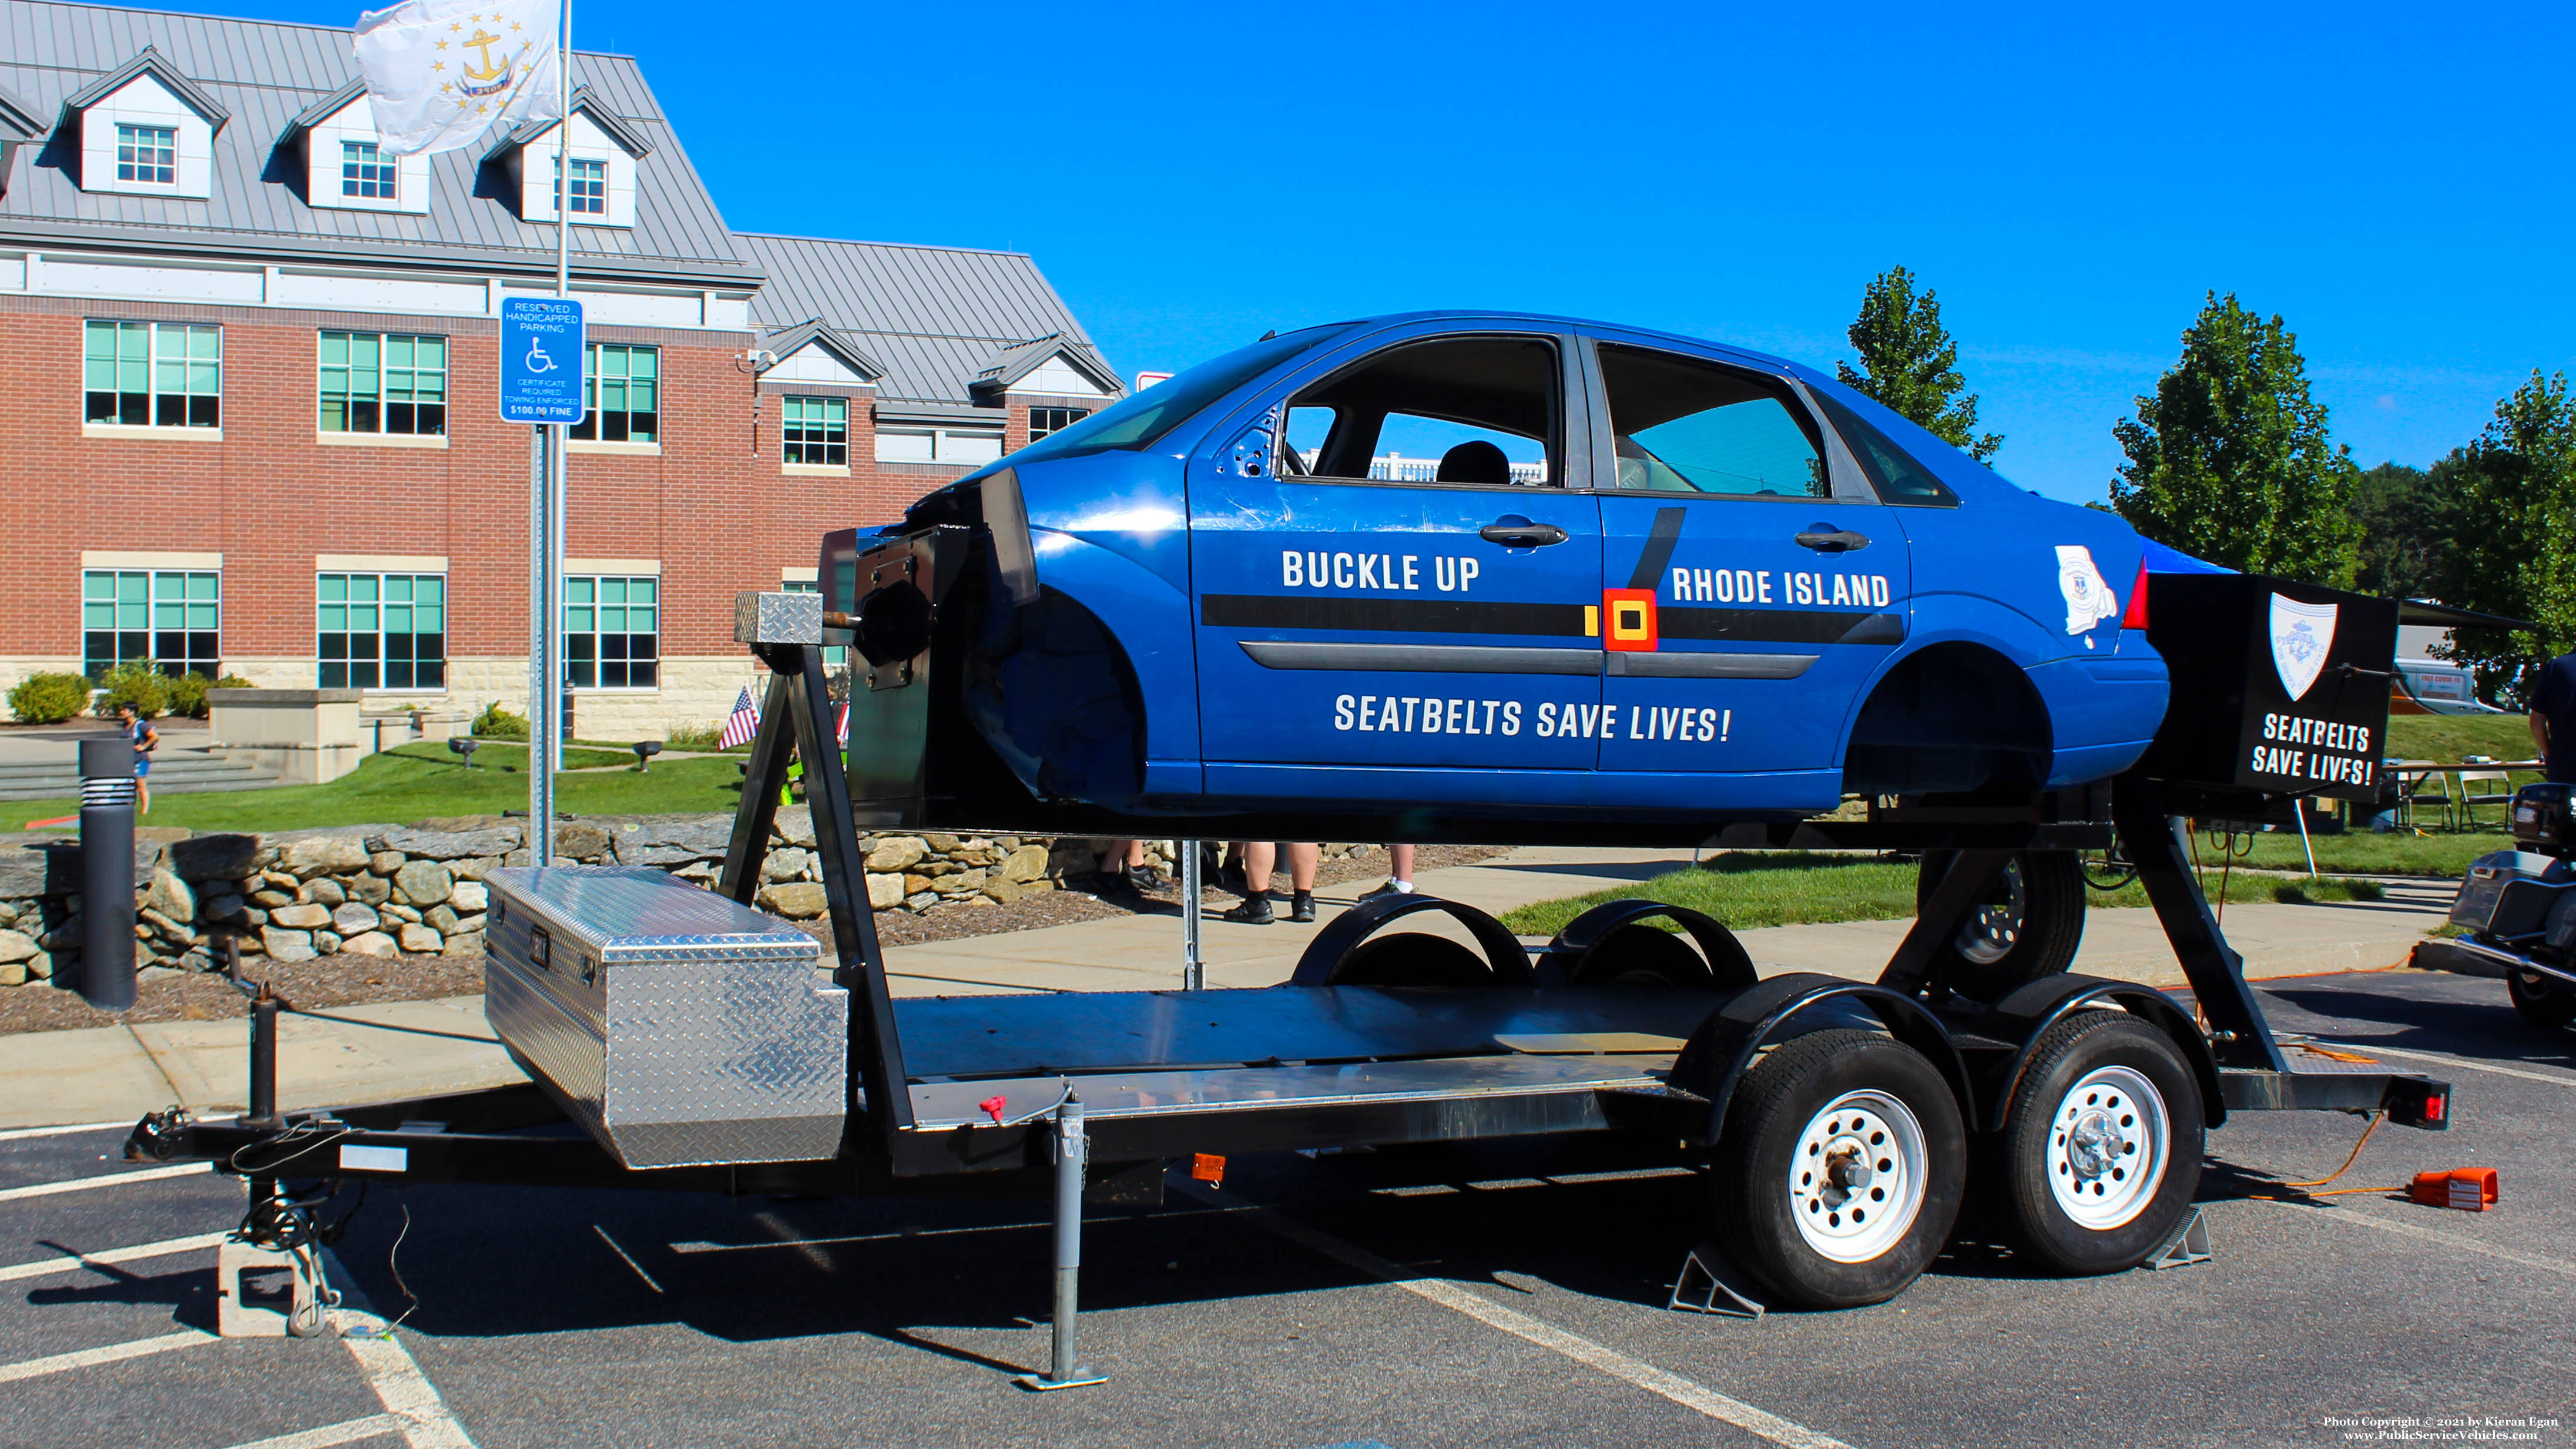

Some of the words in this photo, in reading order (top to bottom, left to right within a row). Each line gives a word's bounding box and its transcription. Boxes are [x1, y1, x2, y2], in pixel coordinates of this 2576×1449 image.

[515, 303, 570, 313] RESERVED
[506, 313, 578, 324] HANDICAPPED
[520, 323, 564, 333] PARKING
[518, 379, 566, 387] CERTIFICATE
[504, 395, 535, 404] TOWING
[537, 397, 580, 405] ENFORCED
[511, 405, 547, 415] $100.00
[550, 407, 572, 415] FINE
[1282, 551, 1419, 590] BUCKLE
[1435, 556, 1479, 591] UP
[1672, 568, 1772, 603] RHODE
[1784, 572, 1890, 607] ISLAND
[1334, 695, 1522, 736] SEATBELTS
[1536, 702, 1616, 739] SAVE
[1630, 706, 1731, 742] LIVES!
[2263, 713, 2370, 752] SEATBELTS
[2252, 746, 2304, 777] SAVE
[2310, 753, 2373, 786] LIVES!
